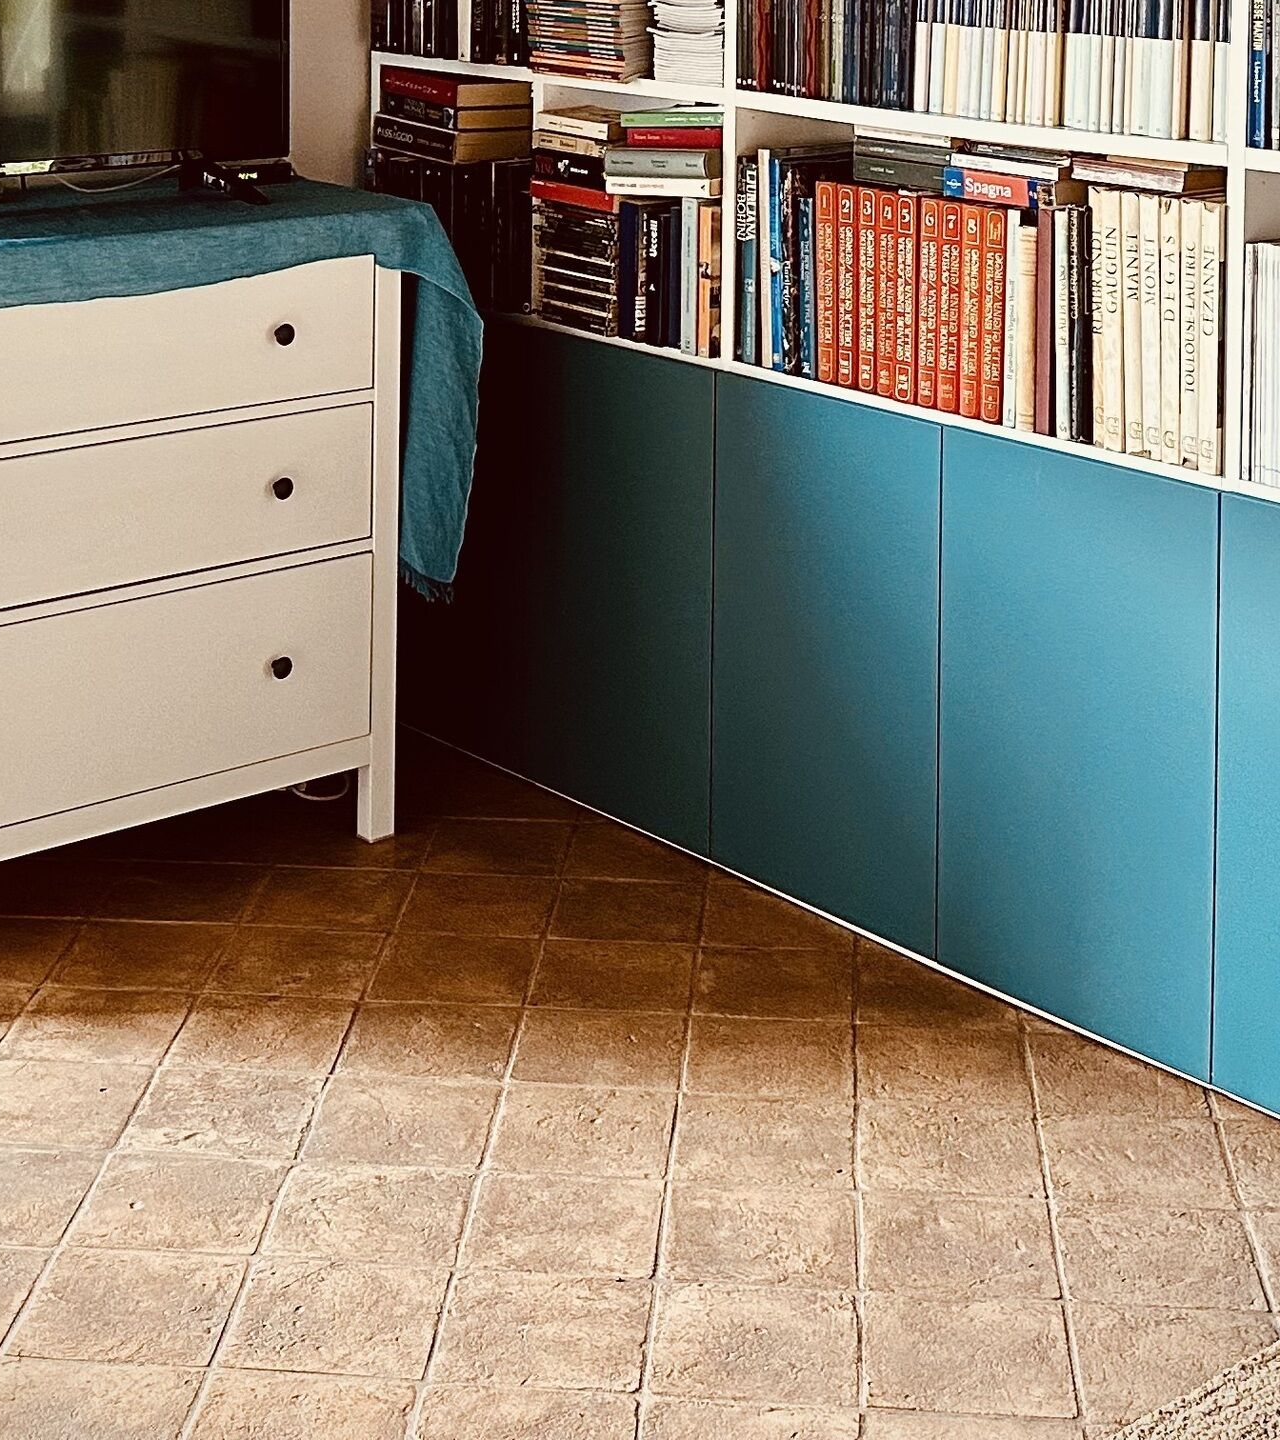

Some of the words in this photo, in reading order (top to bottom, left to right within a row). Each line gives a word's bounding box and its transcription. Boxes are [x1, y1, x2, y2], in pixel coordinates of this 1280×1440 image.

[1253, 21, 1263, 50] MARTIN
[377, 126, 413, 143] PASSAGGIO
[965, 176, 1012, 197] Spagna
[736, 193, 746, 241] BOHINJ
[841, 199, 850, 213] 2
[863, 201, 871, 216] 3
[884, 205, 892, 220] 4
[902, 209, 910, 223] 5
[925, 212, 934, 227] 6
[947, 215, 956, 229] 7
[967, 218, 976, 234] 8
[1069, 210, 1077, 253] DISEGNI
[1070, 255, 1077, 266] DI
[1104, 226, 1118, 314] GAUGUIN
[1126, 231, 1139, 302] MANET
[1144, 234, 1156, 306] MONET
[1092, 229, 1102, 335] REMBRANDT
[1201, 245, 1215, 336] CEZANNE
[1007, 304, 1015, 332] Virginia
[1185, 240, 1196, 393] TOULOUSE-LAUTREC
[904, 328, 912, 362] DELLA
[949, 336, 957, 371] DELLA
